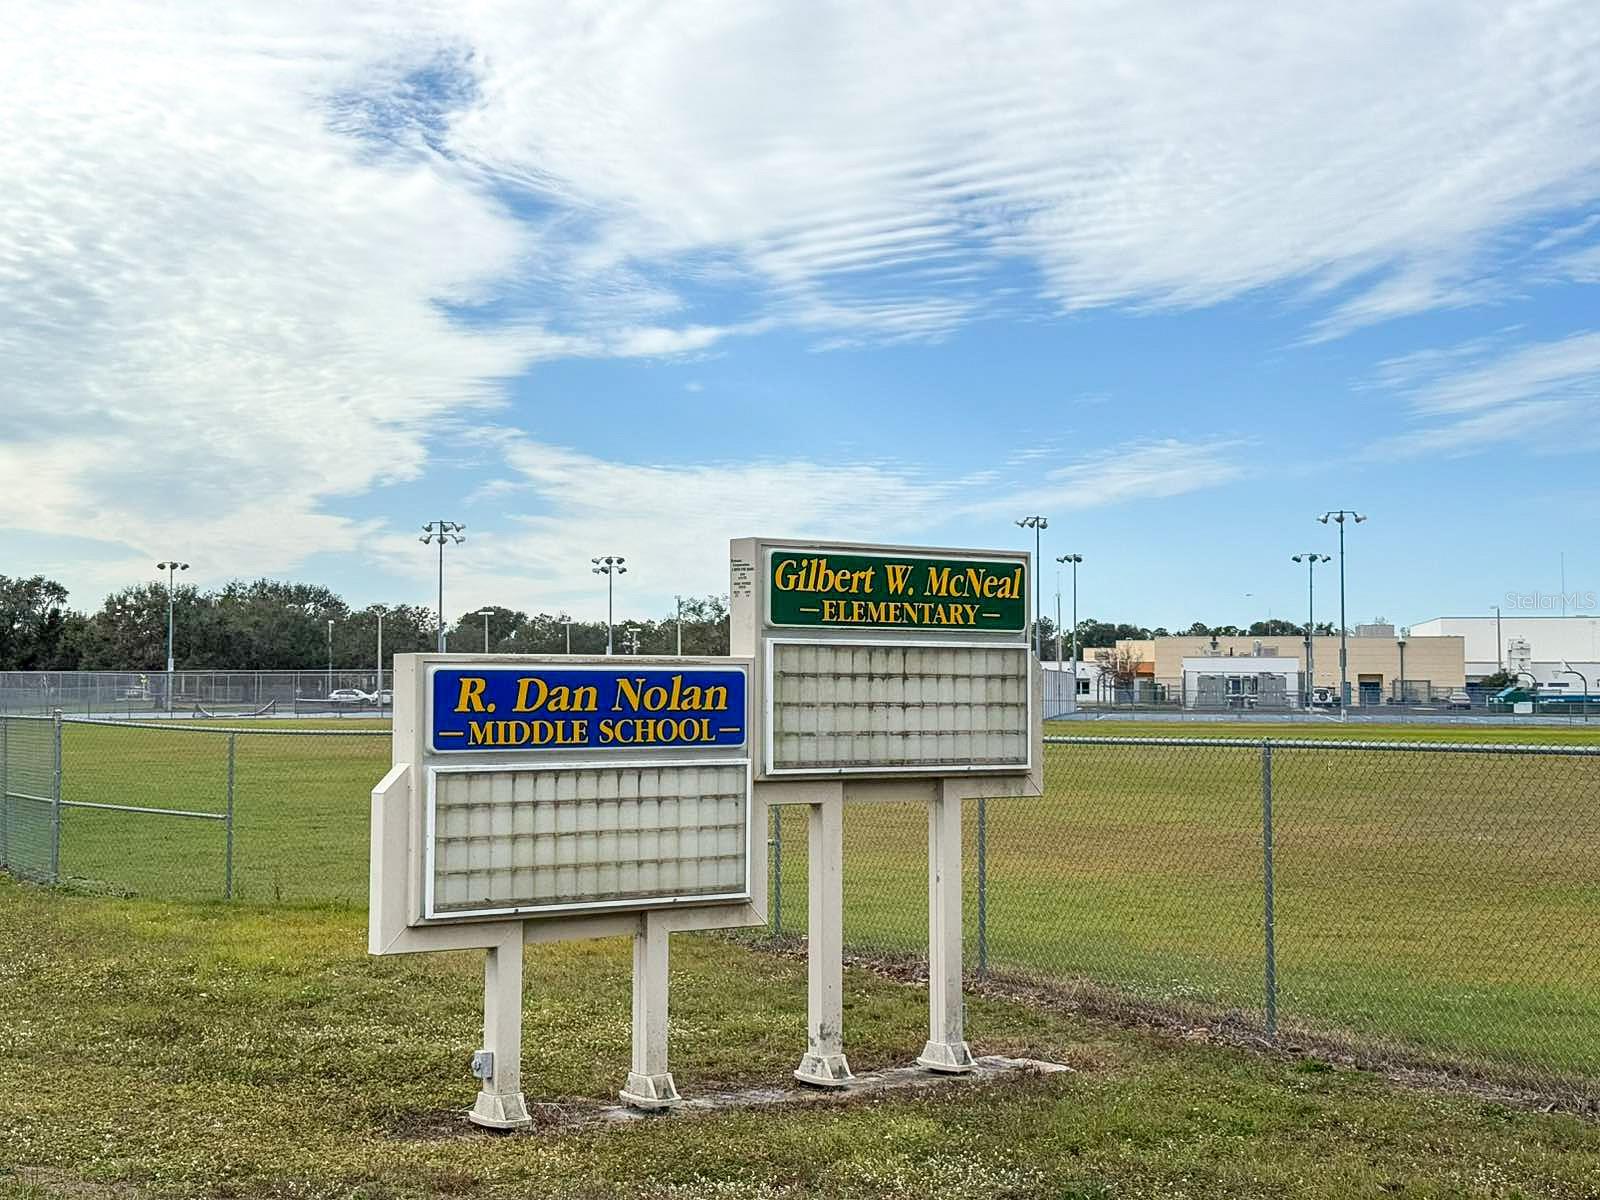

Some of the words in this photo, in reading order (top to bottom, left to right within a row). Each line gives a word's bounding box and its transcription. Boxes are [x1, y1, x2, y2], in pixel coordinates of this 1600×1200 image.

[774, 558, 877, 593] Gilbert
[885, 564, 914, 596] W.
[924, 566, 1023, 600] McNeal
[821, 600, 980, 625] ELEMENTARY
[454, 678, 497, 713] R.
[513, 677, 598, 713] Dan
[612, 674, 728, 711] Nolan
[467, 720, 589, 745] MIDDLE
[599, 718, 716, 743] SCHOOL
